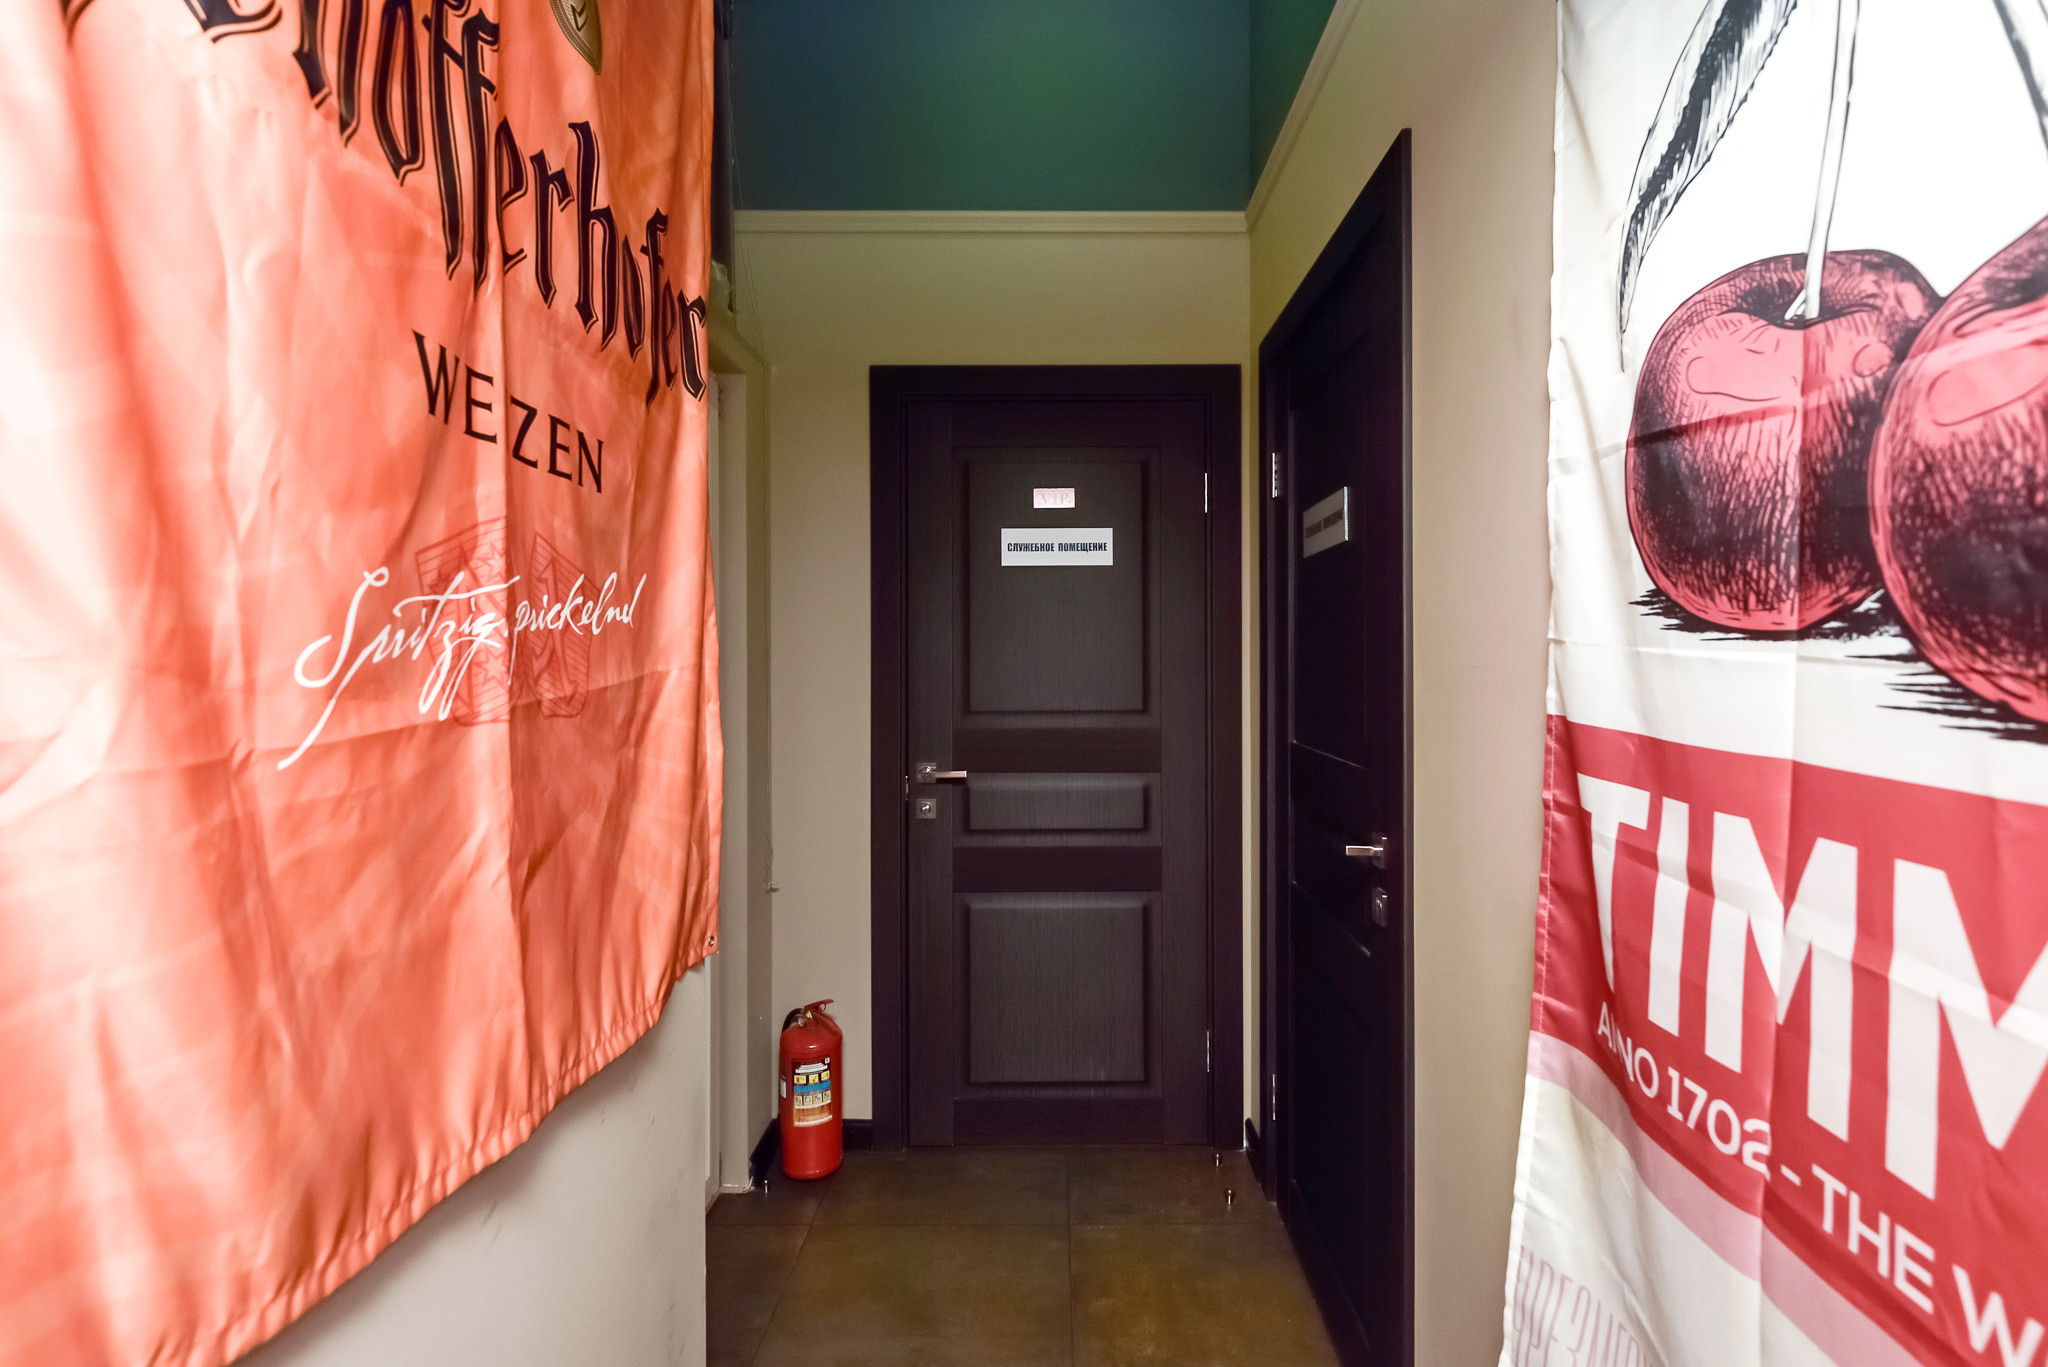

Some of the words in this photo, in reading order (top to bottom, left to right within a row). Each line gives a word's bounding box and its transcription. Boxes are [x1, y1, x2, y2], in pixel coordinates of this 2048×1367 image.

[412, 329, 604, 494] WEZEN
[1039, 493, 1069, 505] VIP
[1007, 542, 1055, 552] СЛУЖЕБНОЕ
[1058, 542, 1108, 553] ПОМЕЩЕНИЕ
[1667, 1066, 1772, 1182] 1702
[1811, 1163, 1936, 1315] THE
[1951, 1263, 2048, 1367] W
